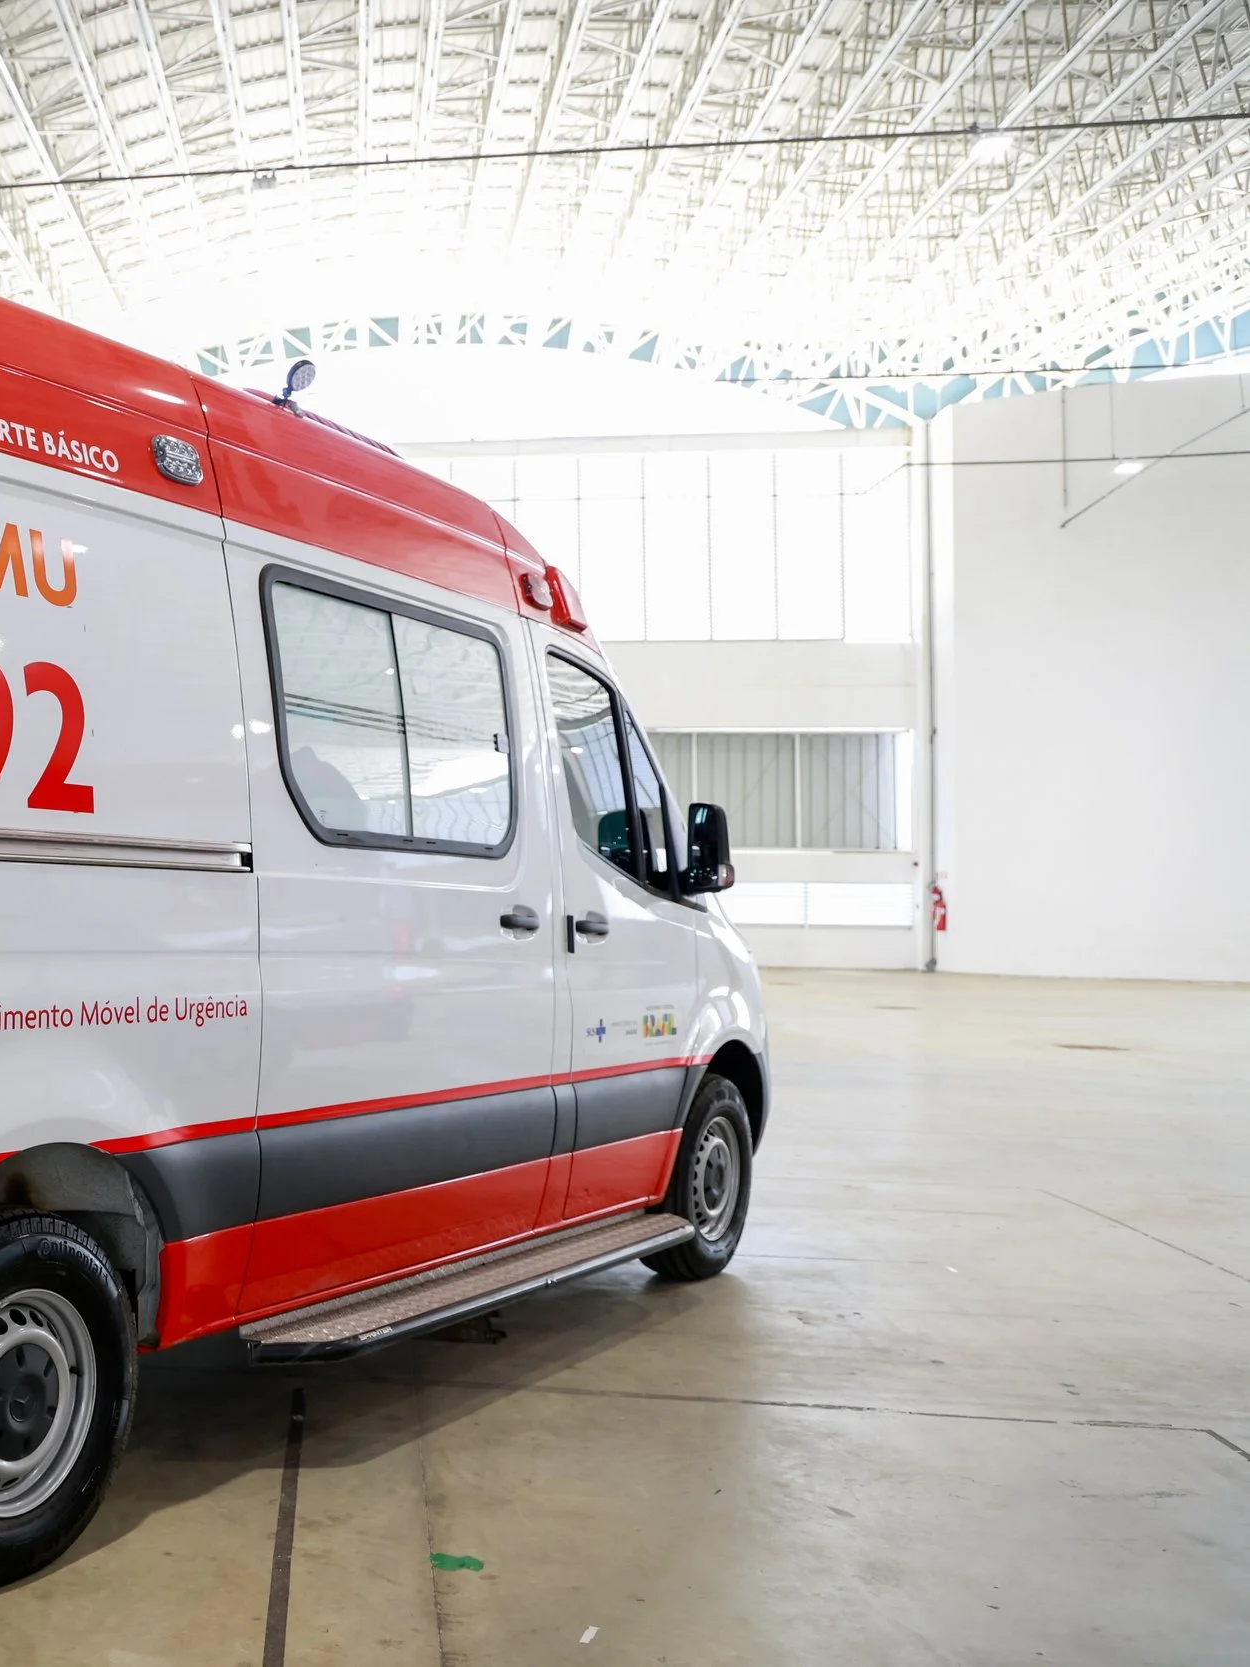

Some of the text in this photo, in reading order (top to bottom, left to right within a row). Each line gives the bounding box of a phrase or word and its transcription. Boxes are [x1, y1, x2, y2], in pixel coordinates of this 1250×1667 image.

[41, 430, 120, 473] BÁSICO
[80, 996, 140, 1026] Móvel
[146, 996, 169, 1023] de
[175, 994, 248, 1028] Urgência
[36, 1237, 103, 1276] Continental
